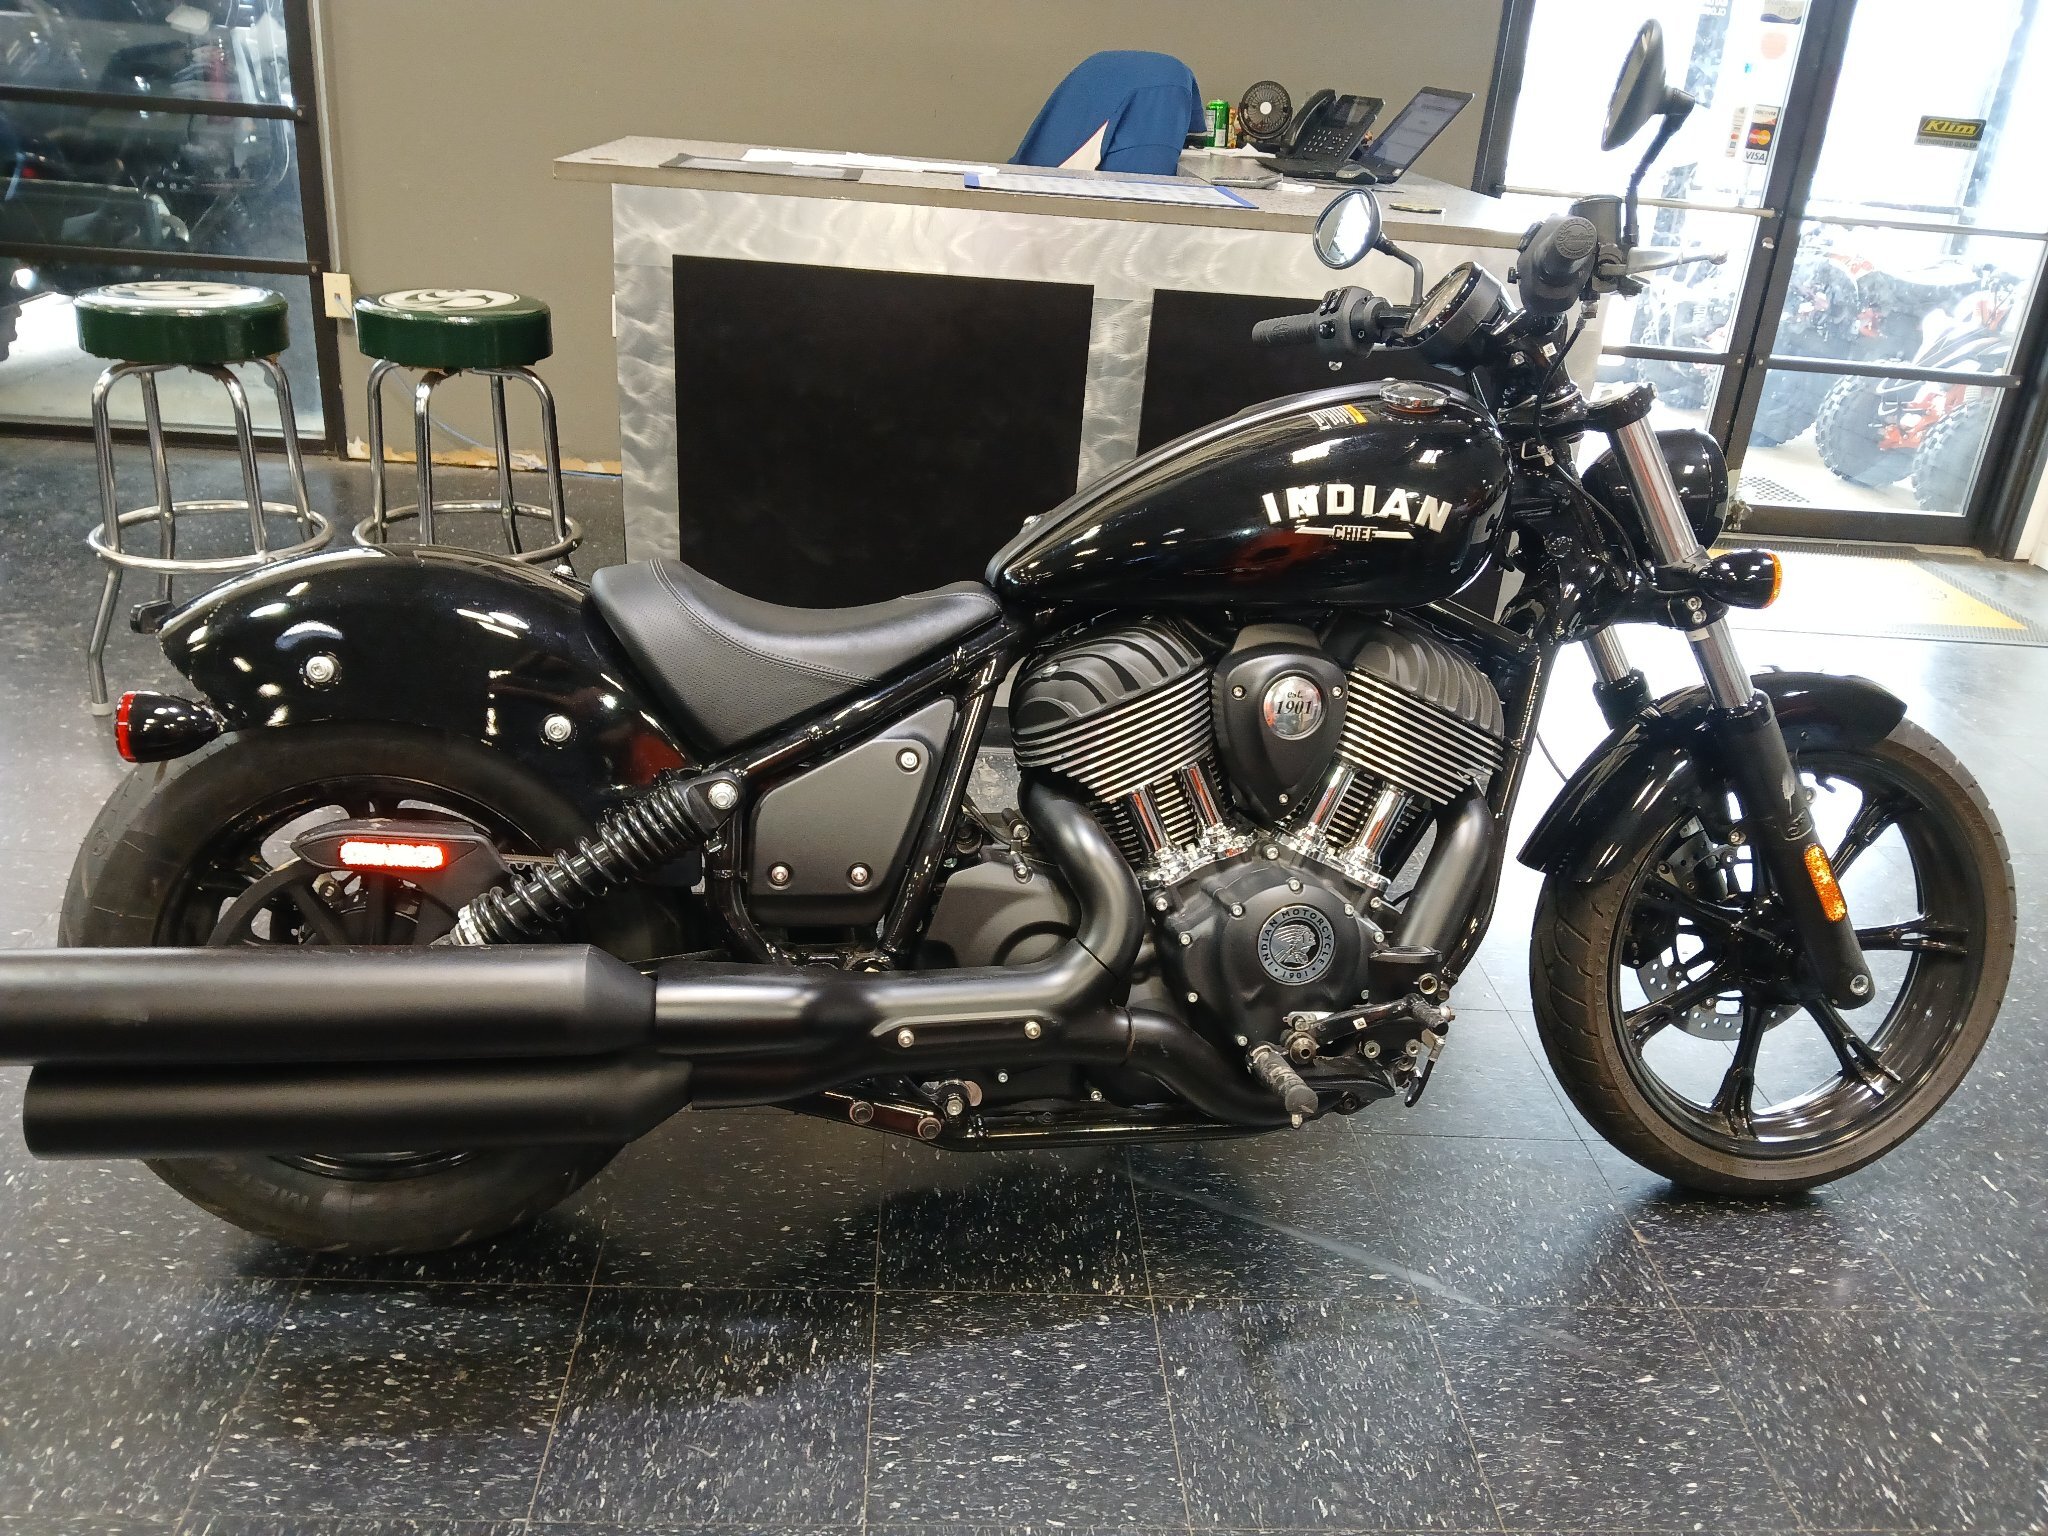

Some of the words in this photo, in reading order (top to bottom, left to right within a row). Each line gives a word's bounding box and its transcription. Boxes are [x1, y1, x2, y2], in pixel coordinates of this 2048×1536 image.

[1923, 119, 1977, 135] Klim
[1954, 140, 1978, 149] DEALER
[1745, 150, 1766, 162] VISA
[1261, 483, 1453, 534] INDIAN
[1333, 525, 1378, 541] CHIEF
[1286, 690, 1303, 699] est.
[1275, 700, 1313, 715] 1901
[1261, 919, 1279, 967] INDIAN
[1281, 908, 1332, 966] MOTORCYCLE
[1282, 970, 1309, 979] 1901
